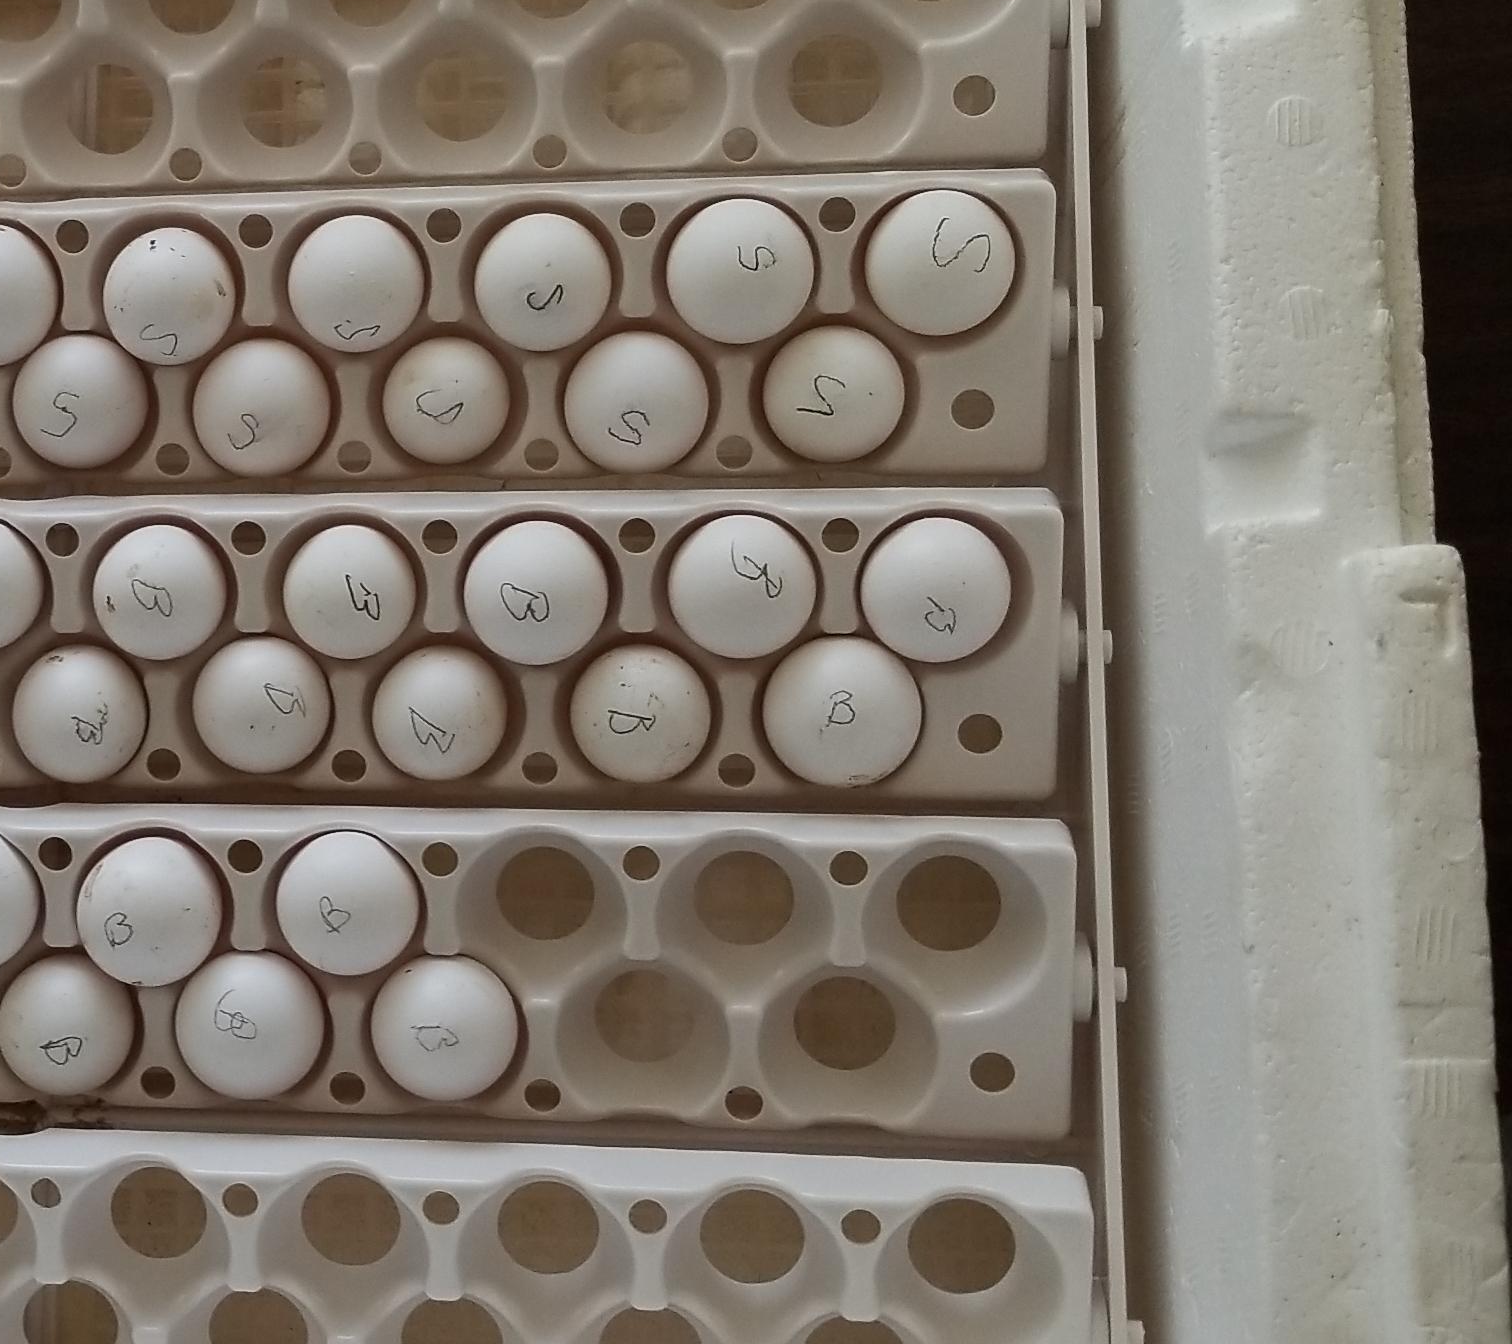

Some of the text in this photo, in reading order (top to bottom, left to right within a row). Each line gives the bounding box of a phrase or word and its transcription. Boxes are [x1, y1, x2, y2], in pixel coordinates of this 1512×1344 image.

[738, 246, 776, 271] S
[931, 217, 992, 274] S
[527, 284, 563, 311] S
[139, 322, 178, 356] S
[334, 320, 381, 340] S
[416, 390, 464, 424] S
[796, 375, 845, 416] S
[40, 392, 80, 437] S
[608, 410, 650, 445] S
[227, 414, 260, 450] S
